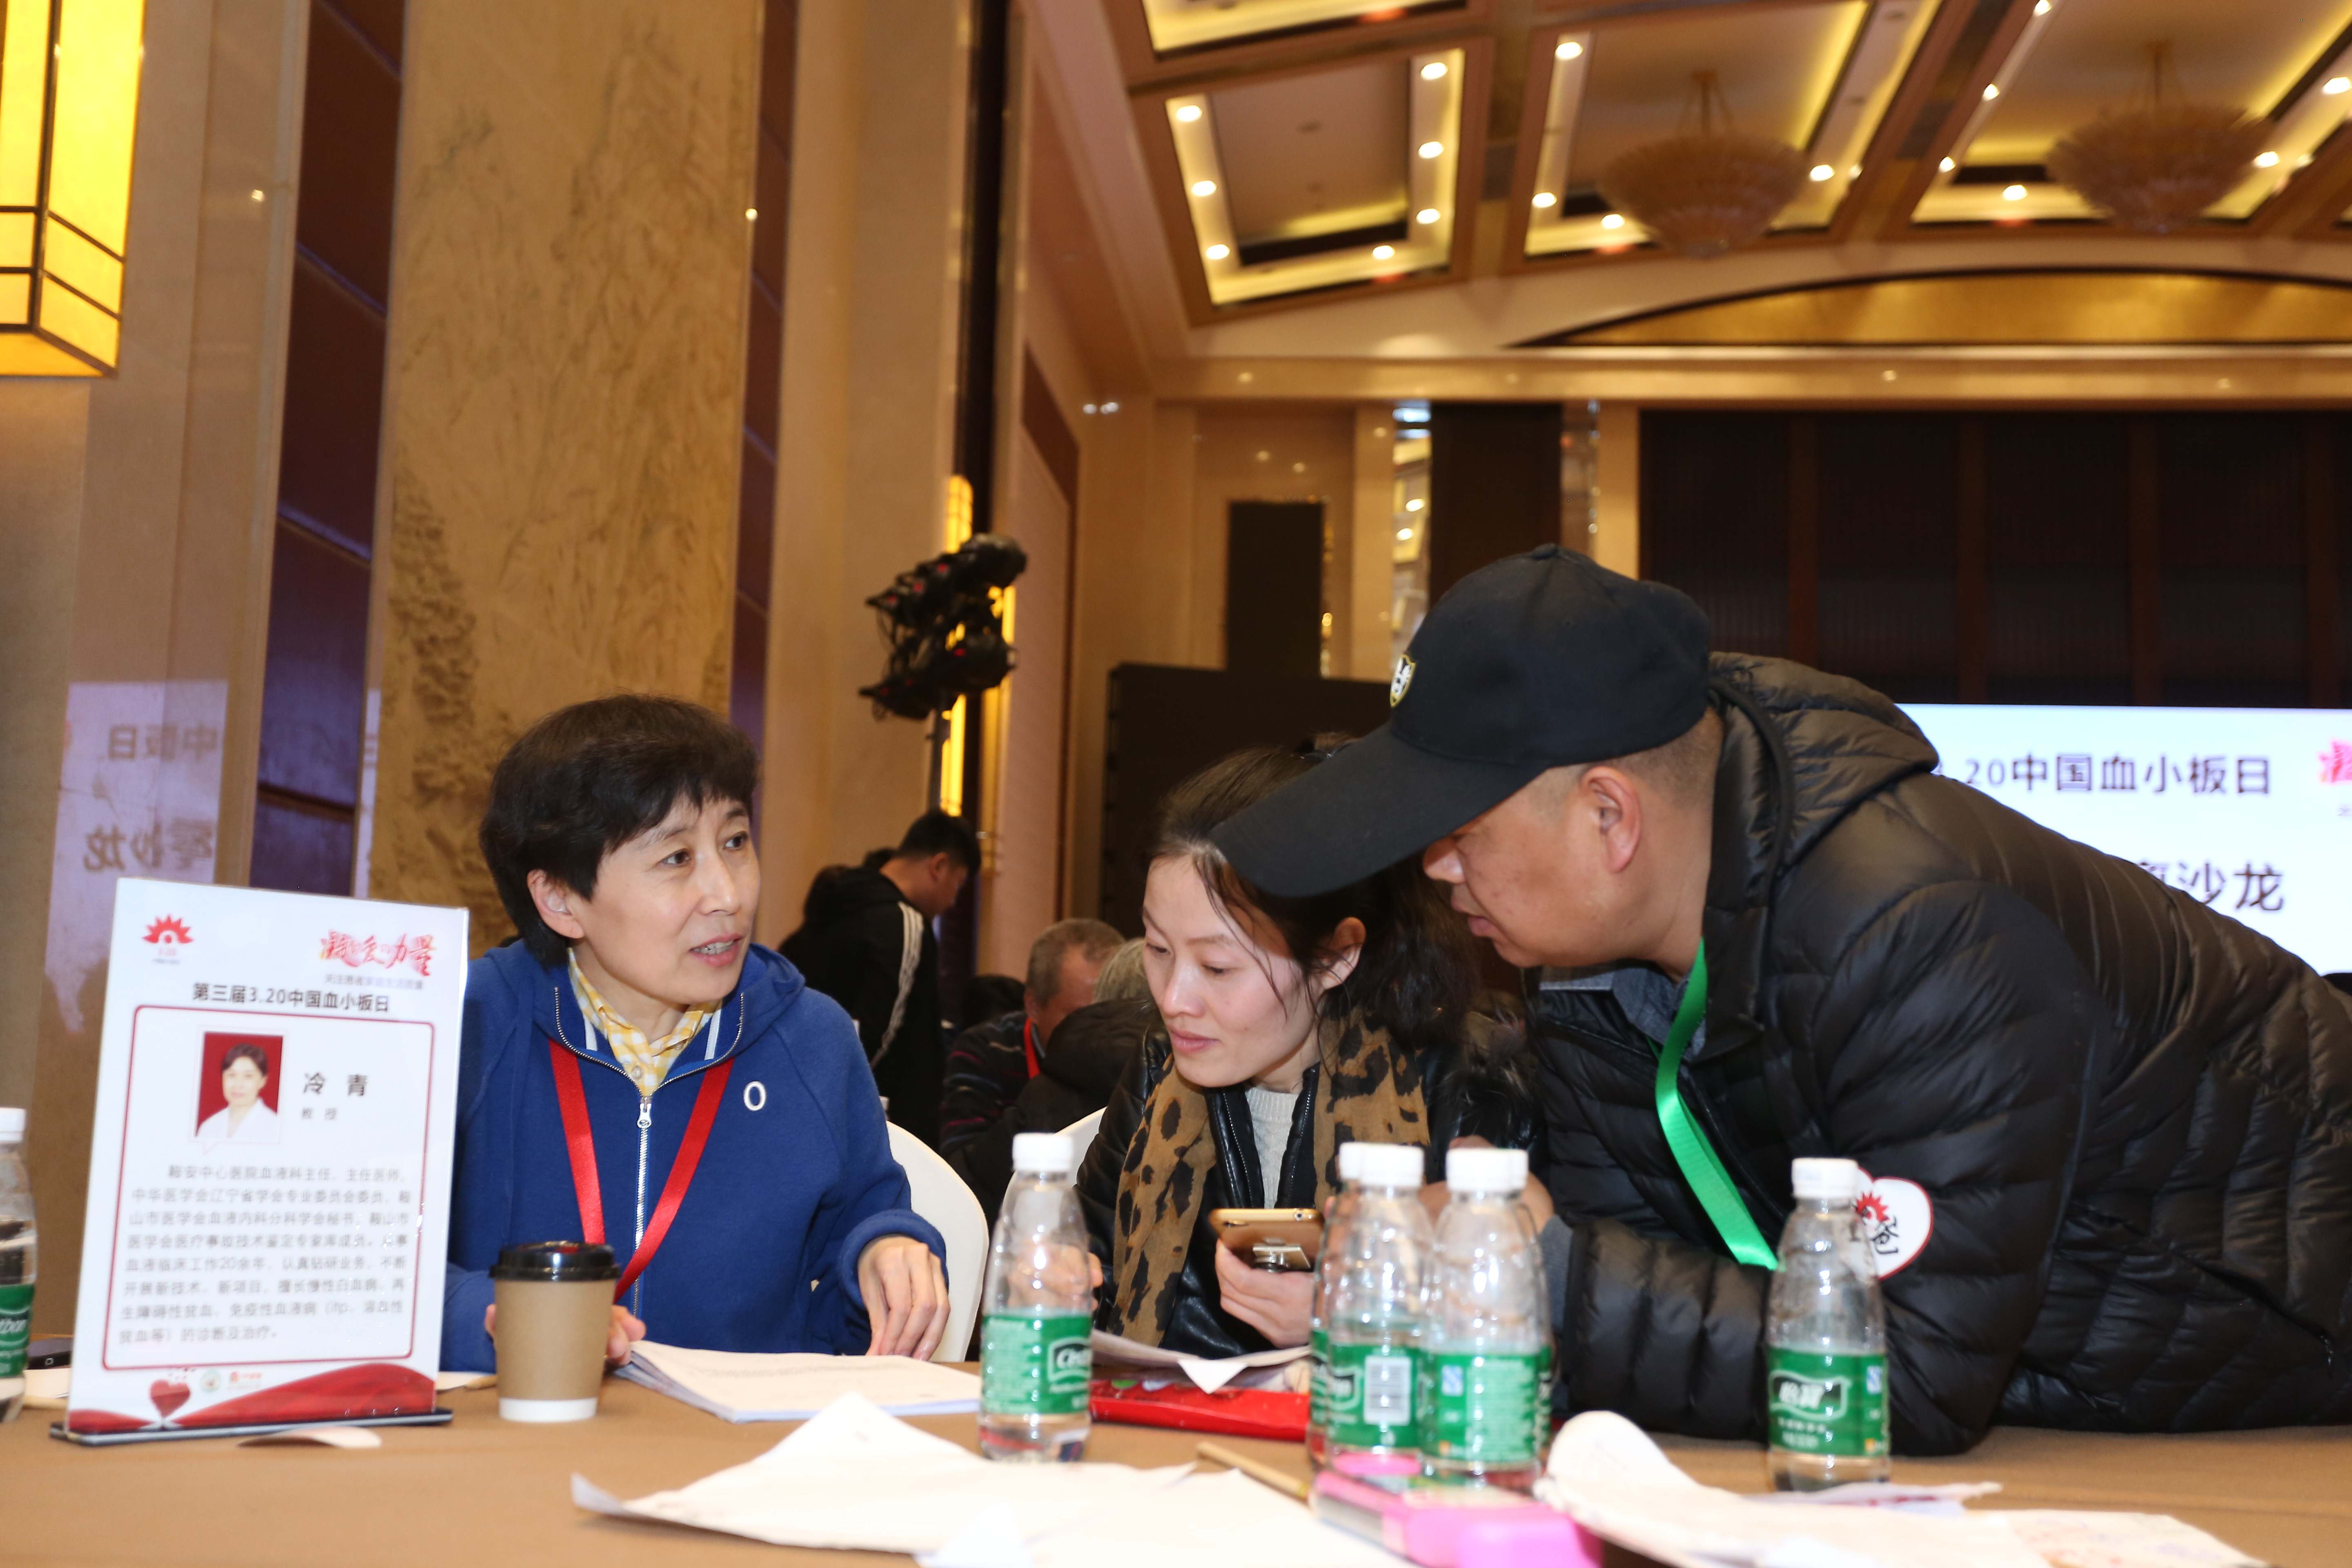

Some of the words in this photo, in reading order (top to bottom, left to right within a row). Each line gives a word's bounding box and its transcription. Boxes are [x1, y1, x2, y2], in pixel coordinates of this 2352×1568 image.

[1936, 753, 2270, 795] 20中国血小板日
[2140, 862, 2283, 911] 沙龙
[193, 982, 389, 1012] 第三届3.20中国血小板日
